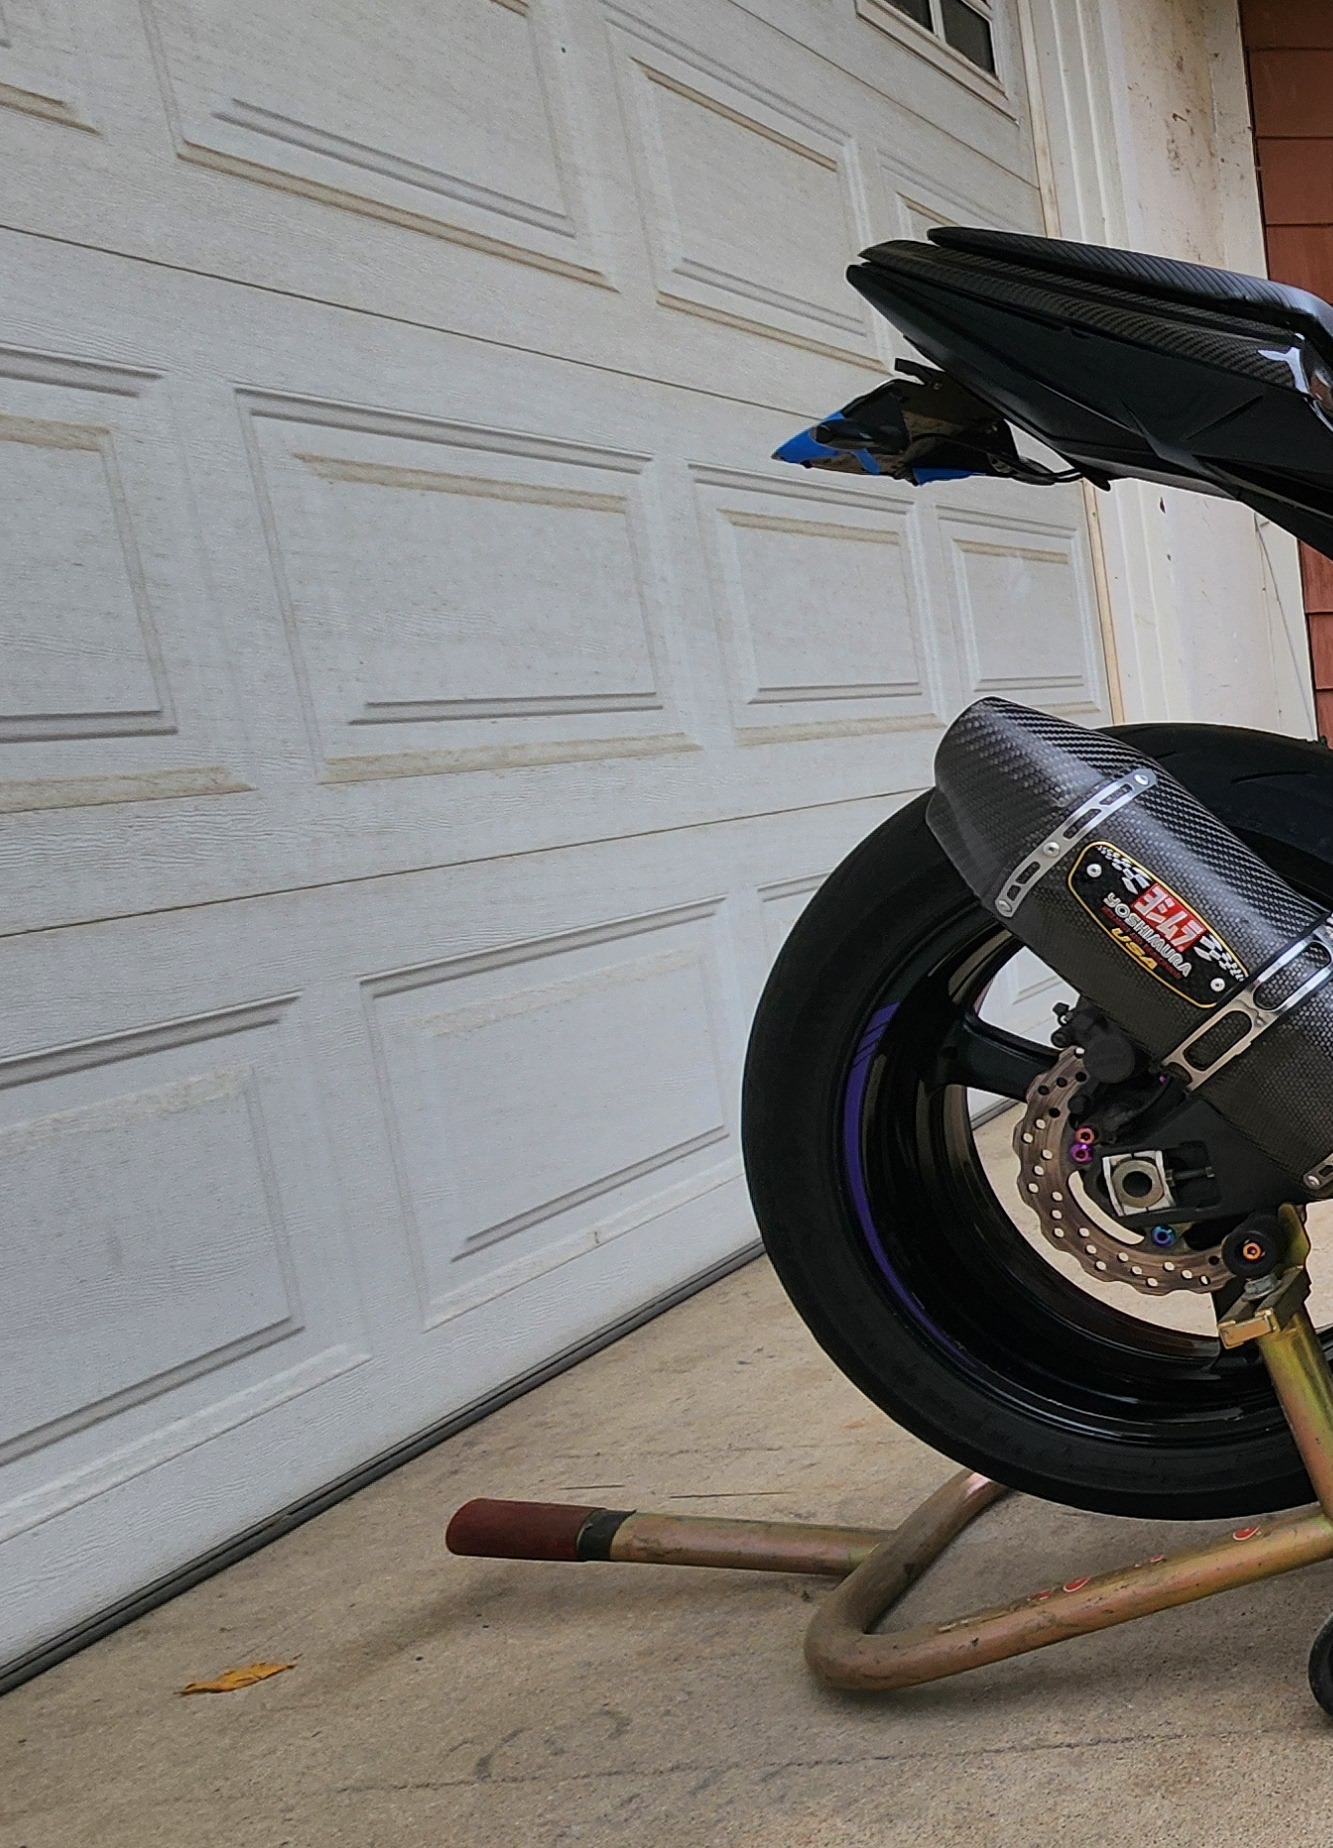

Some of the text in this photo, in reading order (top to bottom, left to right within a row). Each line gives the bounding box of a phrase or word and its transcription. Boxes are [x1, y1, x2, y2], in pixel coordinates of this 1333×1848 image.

[1103, 892, 1193, 978] YOSHIMURA
[1111, 927, 1159, 971] USA
[1132, 885, 1204, 950] ヨシムラ
